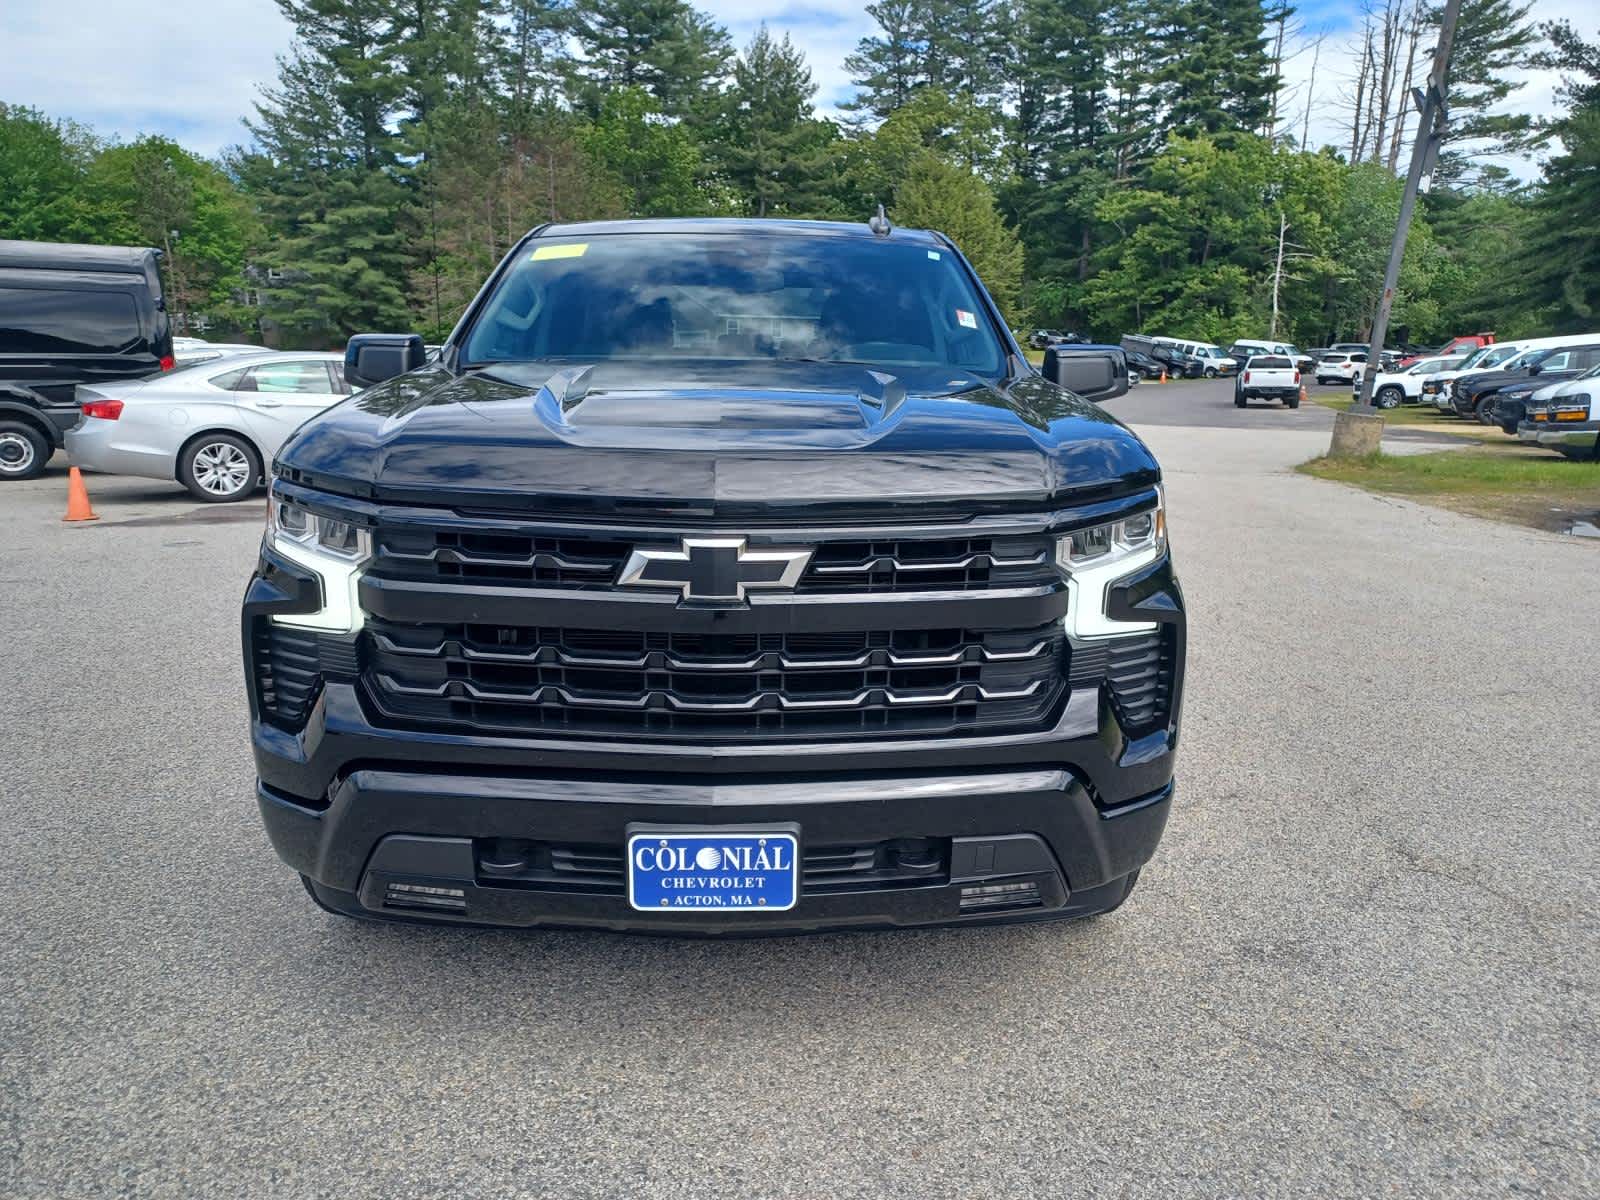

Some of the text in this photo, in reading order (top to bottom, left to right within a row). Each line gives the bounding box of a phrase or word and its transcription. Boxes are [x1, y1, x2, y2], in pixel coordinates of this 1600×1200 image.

[635, 847, 791, 871] COLONIAL
[661, 877, 766, 888] CHEVROLET
[674, 895, 753, 906] ACTON, MA
